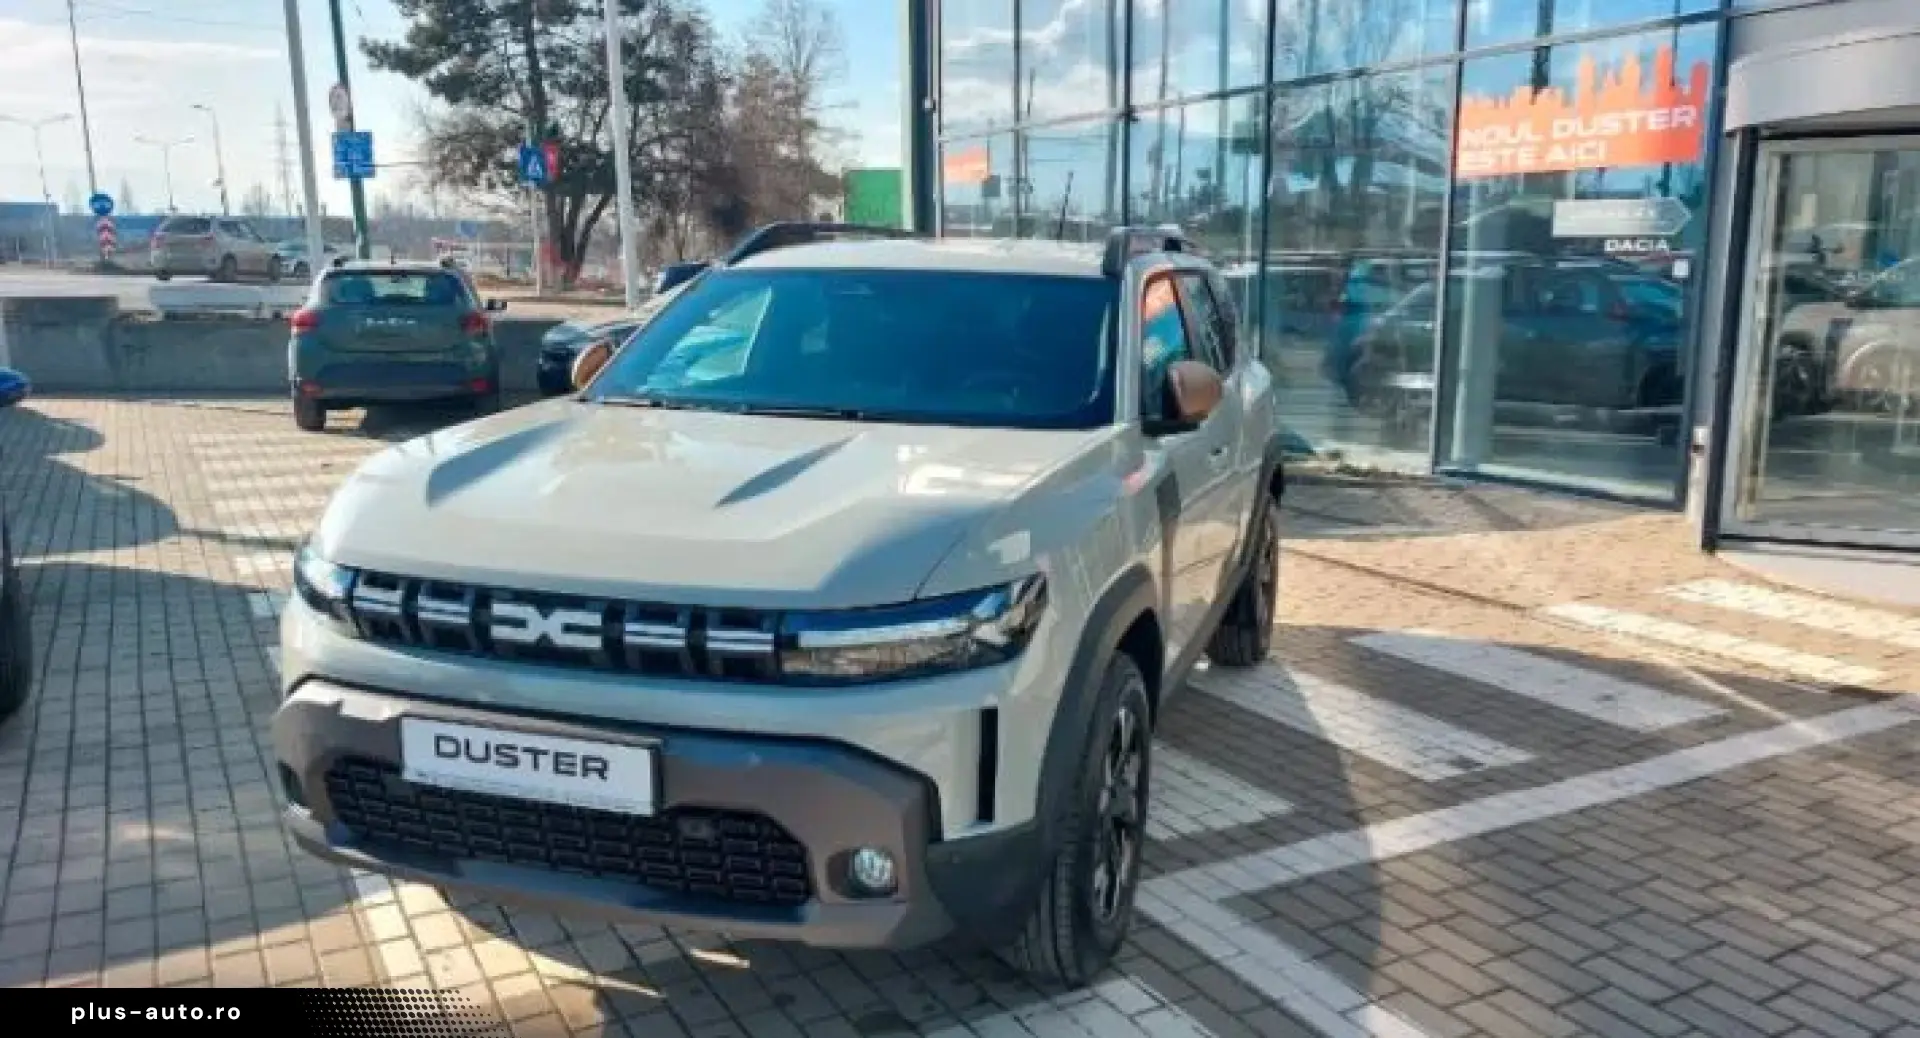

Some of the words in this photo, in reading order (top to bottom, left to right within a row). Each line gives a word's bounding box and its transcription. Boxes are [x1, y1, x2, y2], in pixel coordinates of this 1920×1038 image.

[1461, 122, 1543, 148] NOUL
[1553, 105, 1697, 137] DUSTER
[1459, 146, 1540, 170] ESTE
[1547, 140, 1608, 163] AICI
[1604, 239, 1670, 253] DACIA
[433, 733, 609, 781] DUSTER
